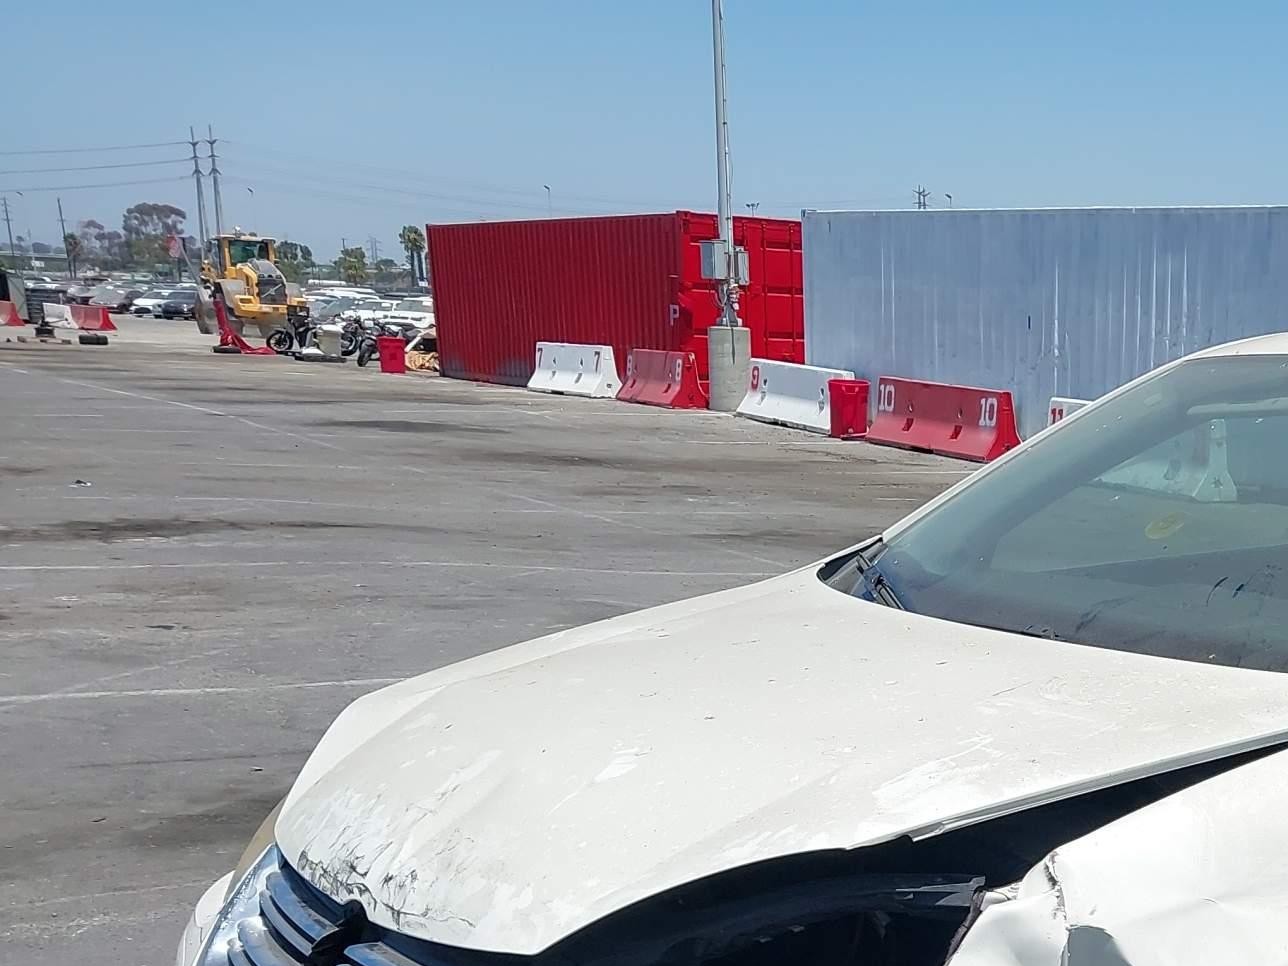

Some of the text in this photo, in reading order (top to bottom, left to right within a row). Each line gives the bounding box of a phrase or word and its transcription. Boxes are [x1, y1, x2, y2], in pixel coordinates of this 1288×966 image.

[669, 304, 680, 327] P
[537, 347, 544, 369] 7
[593, 350, 601, 373] 7
[626, 354, 633, 376] 8
[675, 358, 683, 382] 8
[878, 383, 896, 412] 10
[978, 397, 998, 427] 10
